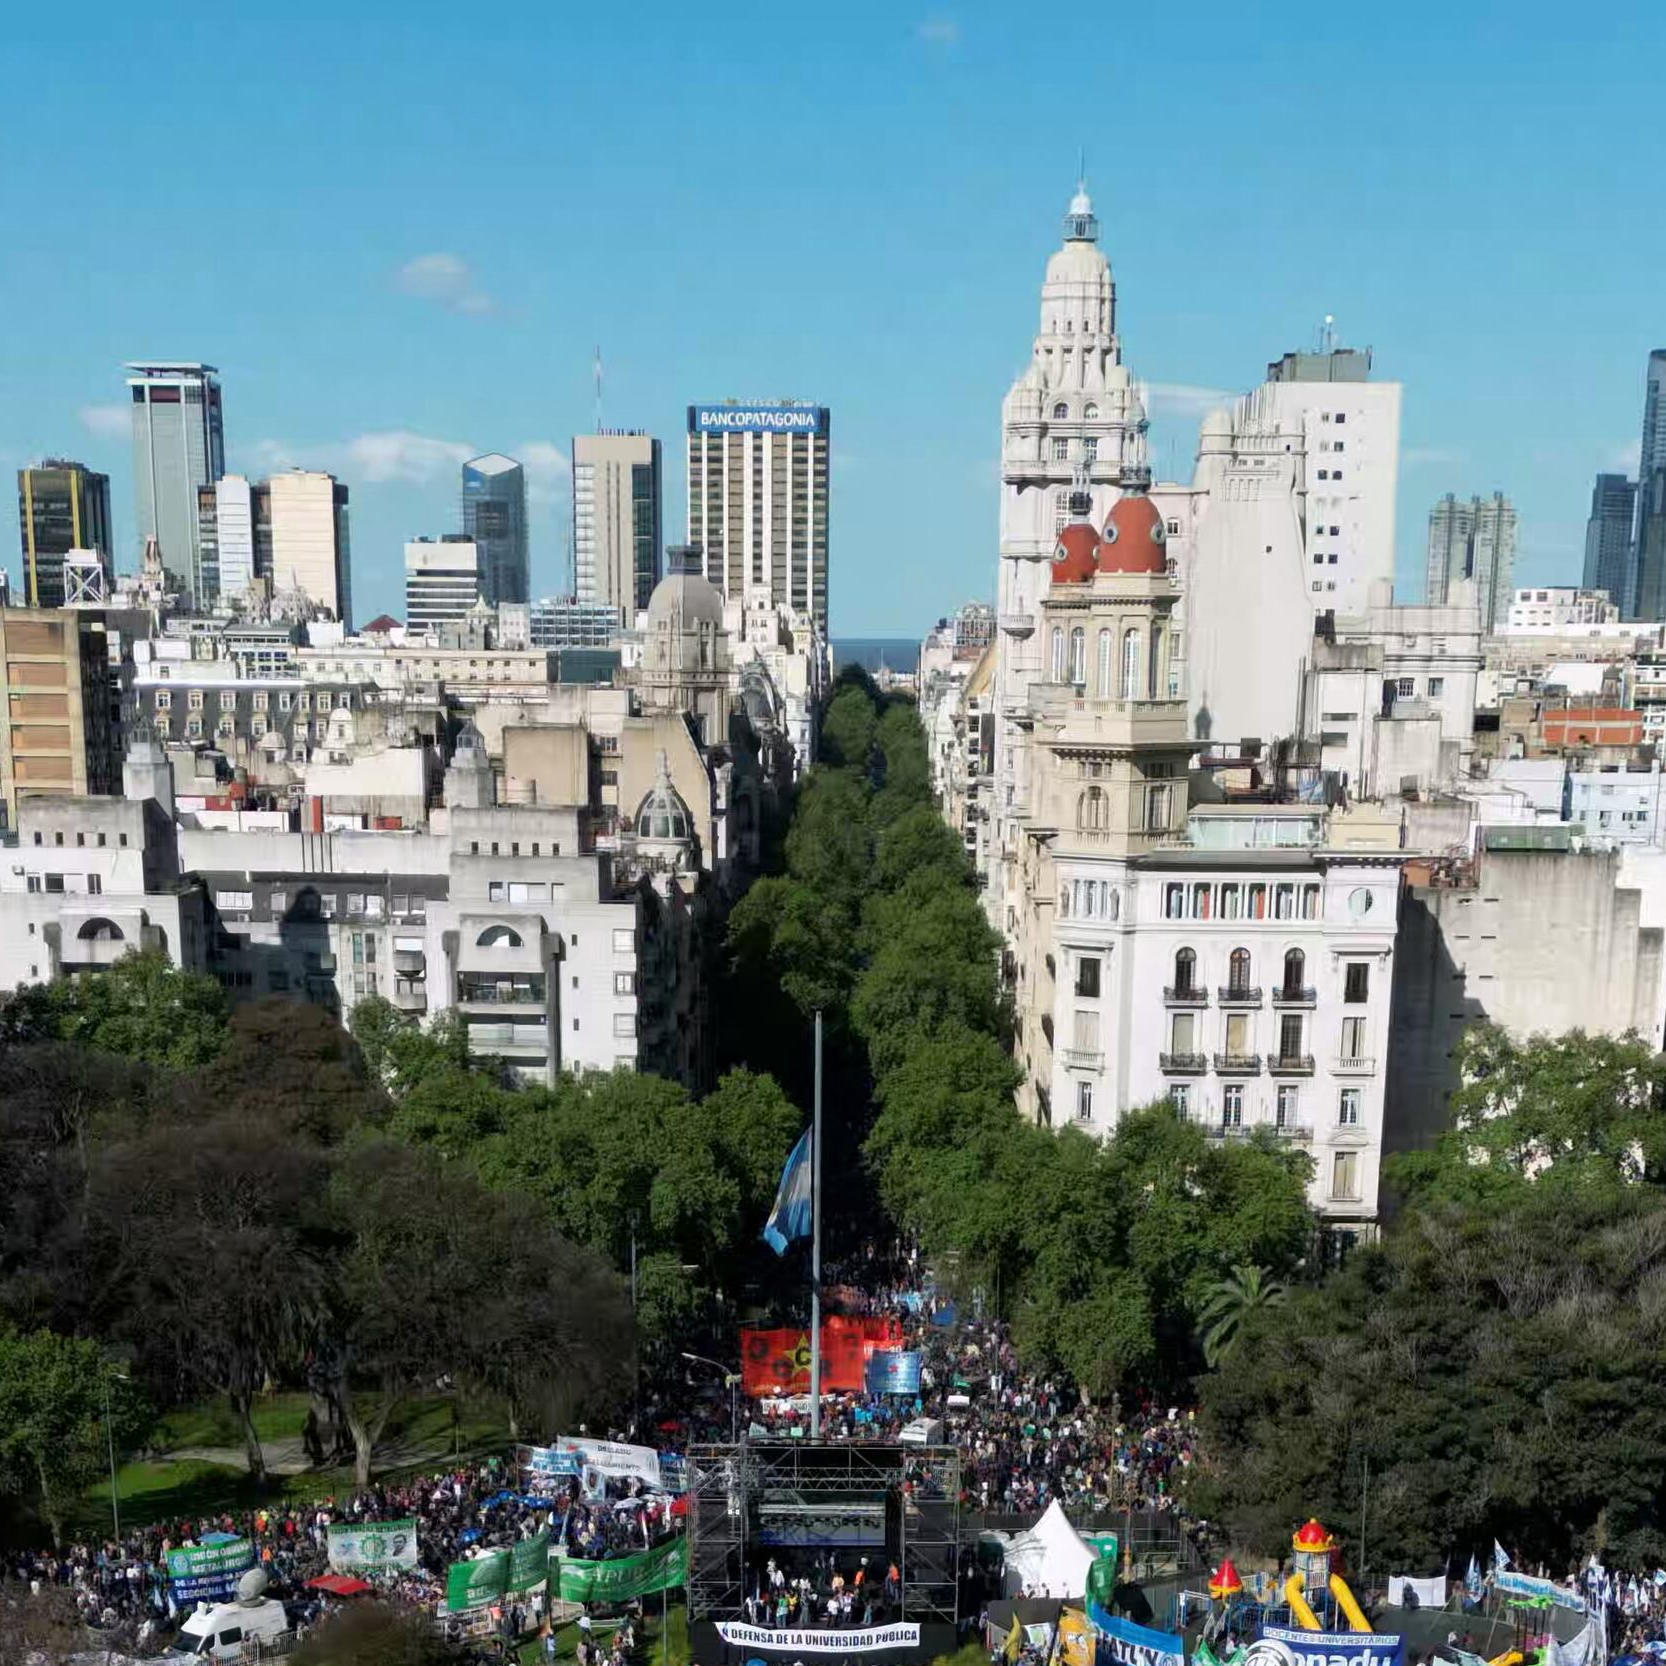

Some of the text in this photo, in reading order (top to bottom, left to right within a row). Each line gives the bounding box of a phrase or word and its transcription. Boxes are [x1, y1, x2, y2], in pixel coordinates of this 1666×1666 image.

[731, 1629, 918, 1648] DEFENSA DE LA UNIVERSIDAD PÚBLICA
[1263, 1628, 1398, 1645] DOCENTES UNIVERSITARIOS
